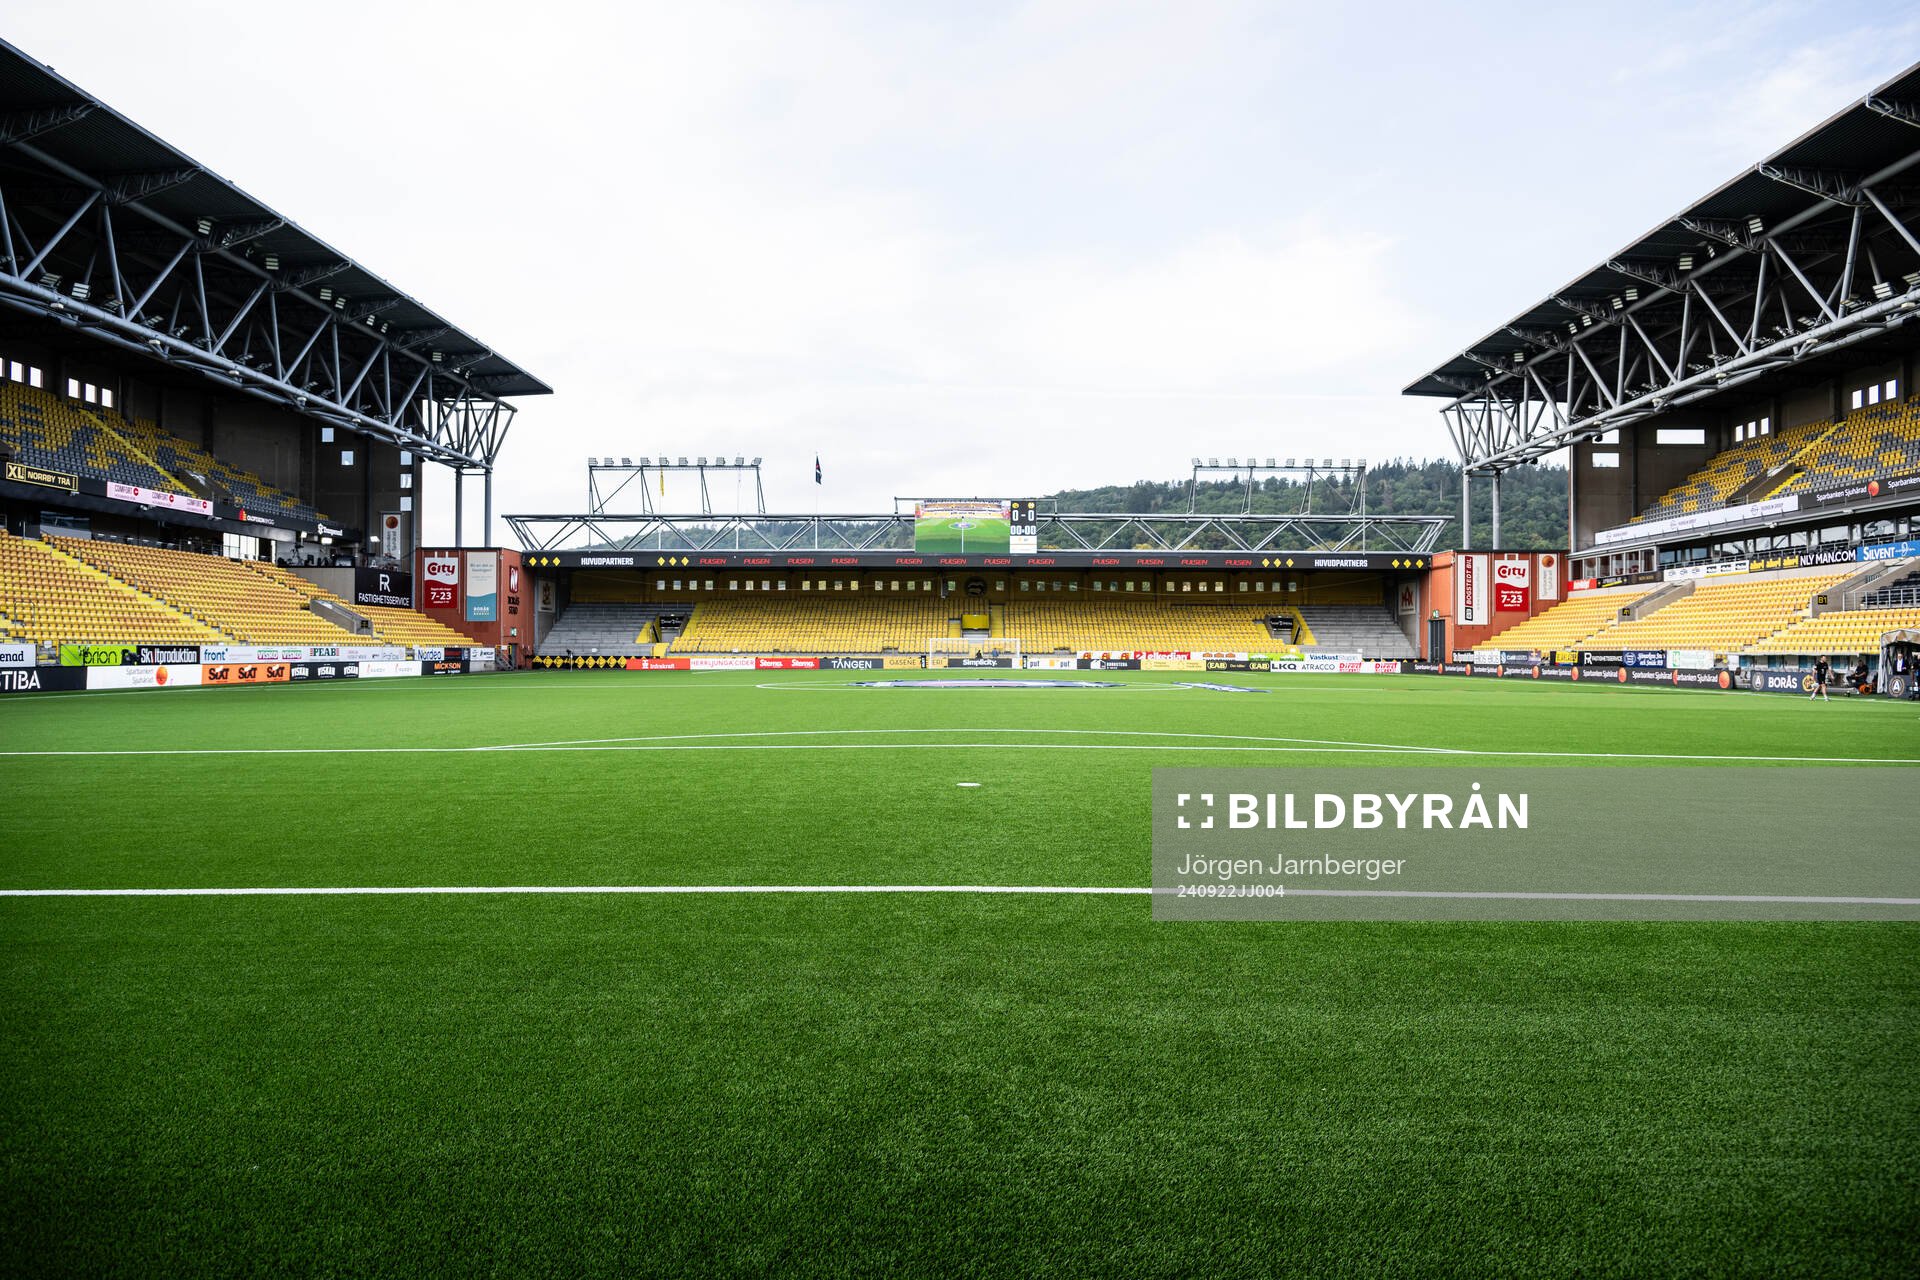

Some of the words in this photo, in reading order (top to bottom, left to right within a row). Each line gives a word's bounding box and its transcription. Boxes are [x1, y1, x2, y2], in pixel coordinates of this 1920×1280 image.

[8, 465, 24, 479] XL
[27, 471, 56, 483] NORRBY
[1816, 490, 1844, 501] Sparbanken
[1863, 546, 1895, 561] SILVENT
[580, 557, 634, 566] HUVUDPARTNERS
[1314, 559, 1368, 567] HUVUDPARTNERS
[358, 592, 410, 606] FASTIGHETSSERVICE
[431, 592, 452, 600] 7-23
[1500, 594, 1523, 603] 7-23
[1818, 596, 1827, 604] B1
[204, 649, 226, 661] front
[313, 648, 336, 657] PEAB
[418, 649, 442, 660] Nordea
[0, 670, 41, 690] TIBA
[1676, 674, 1696, 682] arbanken
[1768, 675, 1798, 689] BORÅS
